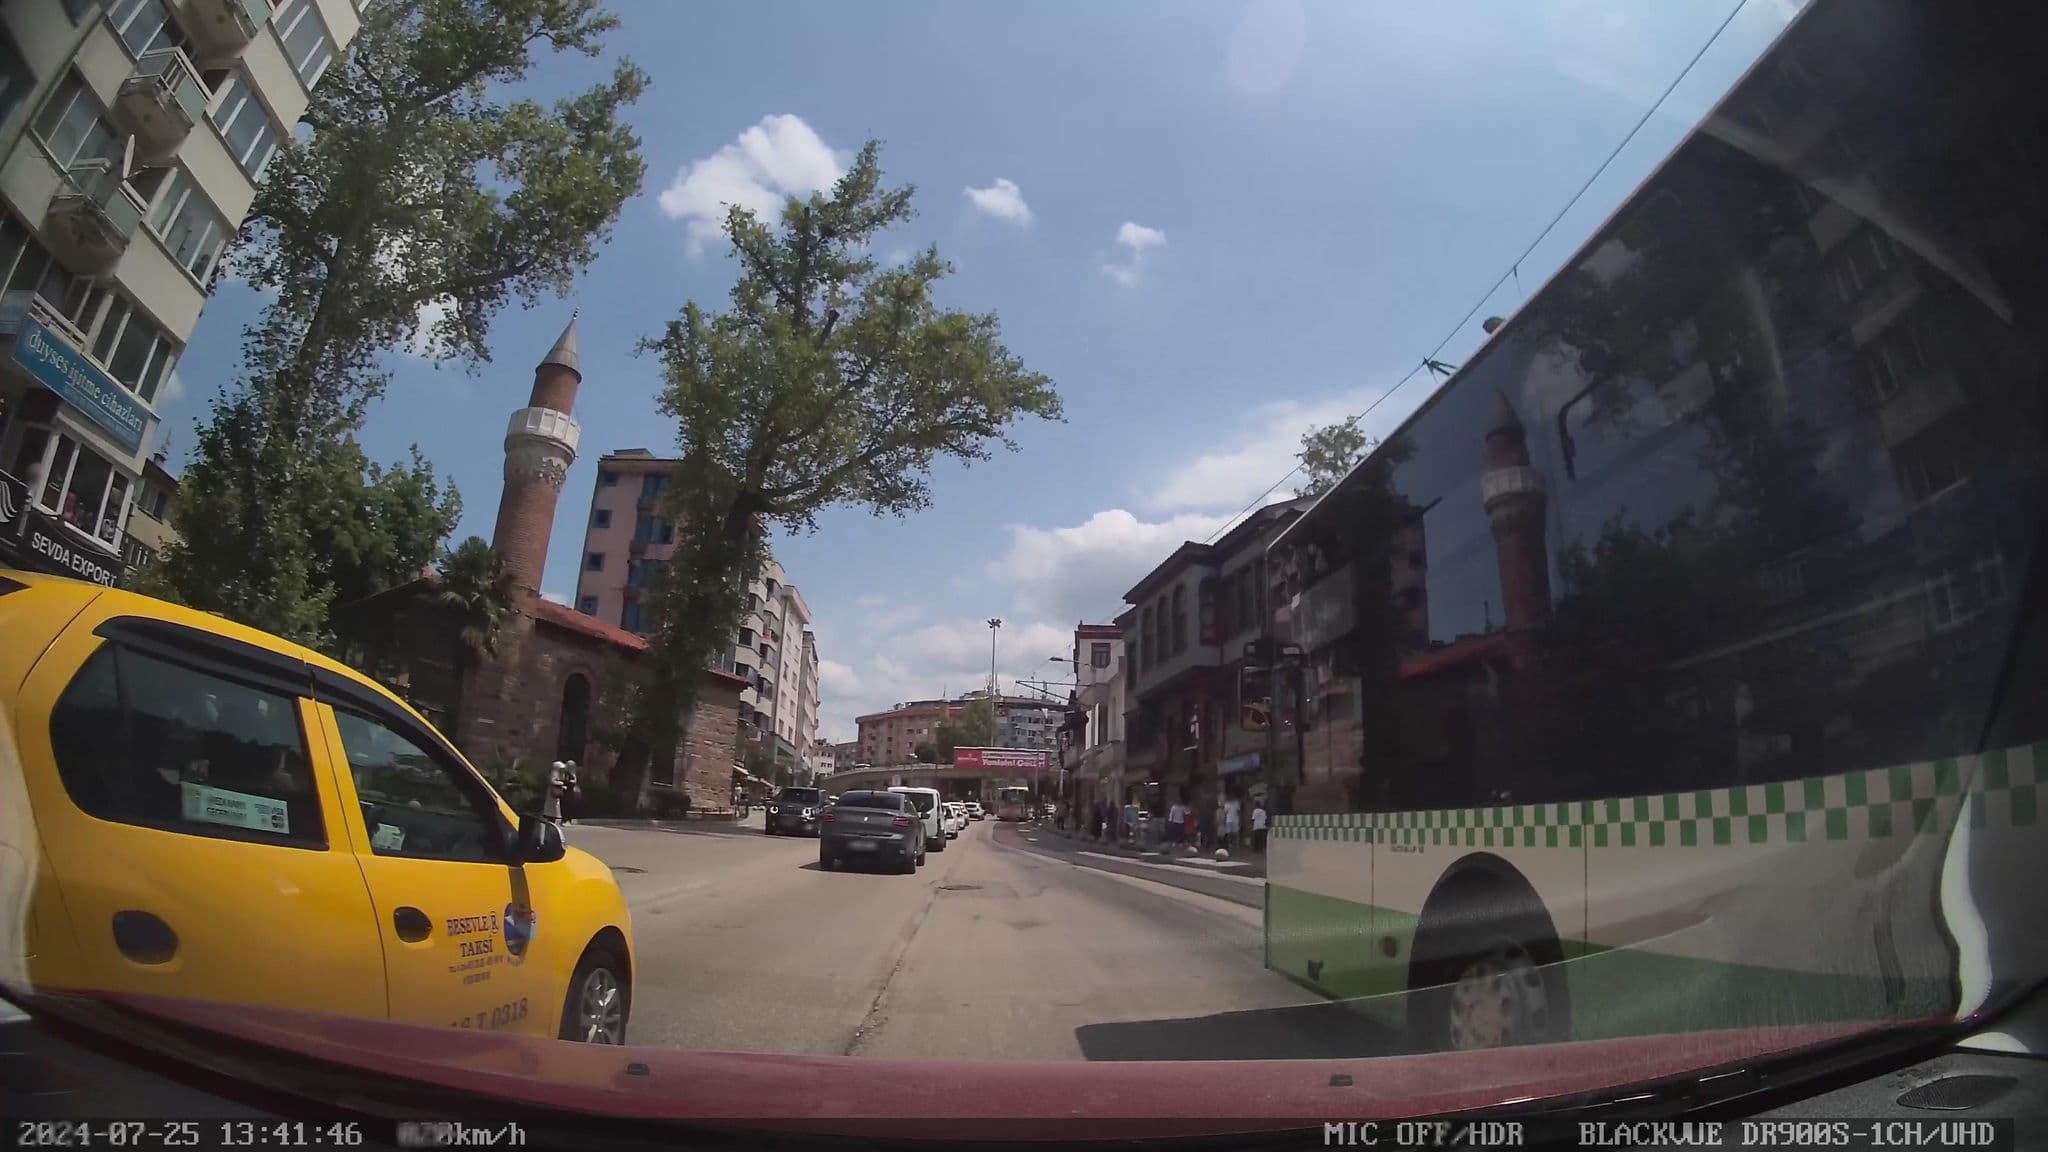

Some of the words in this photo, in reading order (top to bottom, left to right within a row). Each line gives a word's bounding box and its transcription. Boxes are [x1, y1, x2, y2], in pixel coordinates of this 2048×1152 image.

[29, 330, 69, 374] duyses
[32, 532, 70, 567] SEVDA
[72, 552, 117, 588] EXPORT
